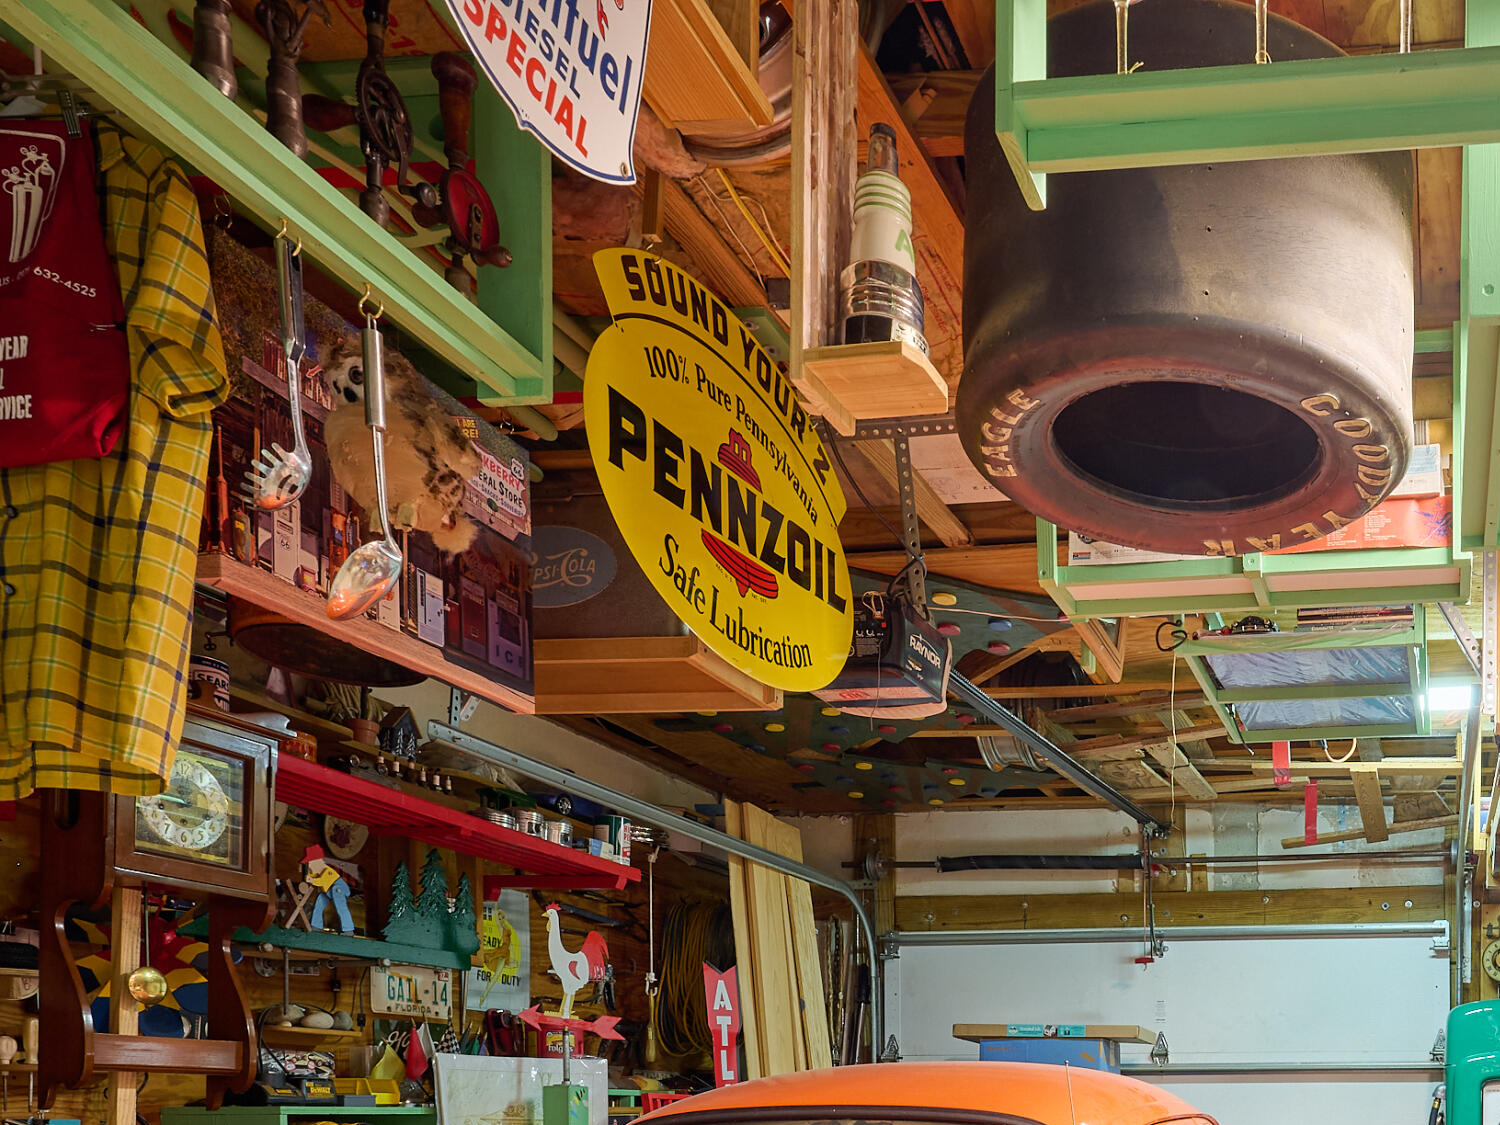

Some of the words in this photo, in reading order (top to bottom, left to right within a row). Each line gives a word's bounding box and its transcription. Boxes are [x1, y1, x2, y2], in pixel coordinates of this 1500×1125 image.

[463, 0, 588, 158] SPECIAL
[501, 0, 581, 99] IESEL
[33, 266, 97, 298] 632-4525
[620, 254, 730, 348] SOUND
[739, 323, 806, 446] YOUR
[644, 345, 690, 385] 100%
[695, 362, 732, 414] Pure
[736, 394, 819, 527] Pennsylvania
[981, 387, 1041, 477] EAGLE
[498, 480, 523, 508] STORE
[607, 384, 848, 616] PENNZOIL
[659, 533, 707, 616] Safe
[710, 584, 814, 670] Lubrication
[909, 634, 941, 669] RAYNOR
[395, 1003, 432, 1014] FLORIDA
[476, 970, 492, 981] FOR
[501, 975, 522, 988] DUTY
[713, 979, 735, 1087] ATL
